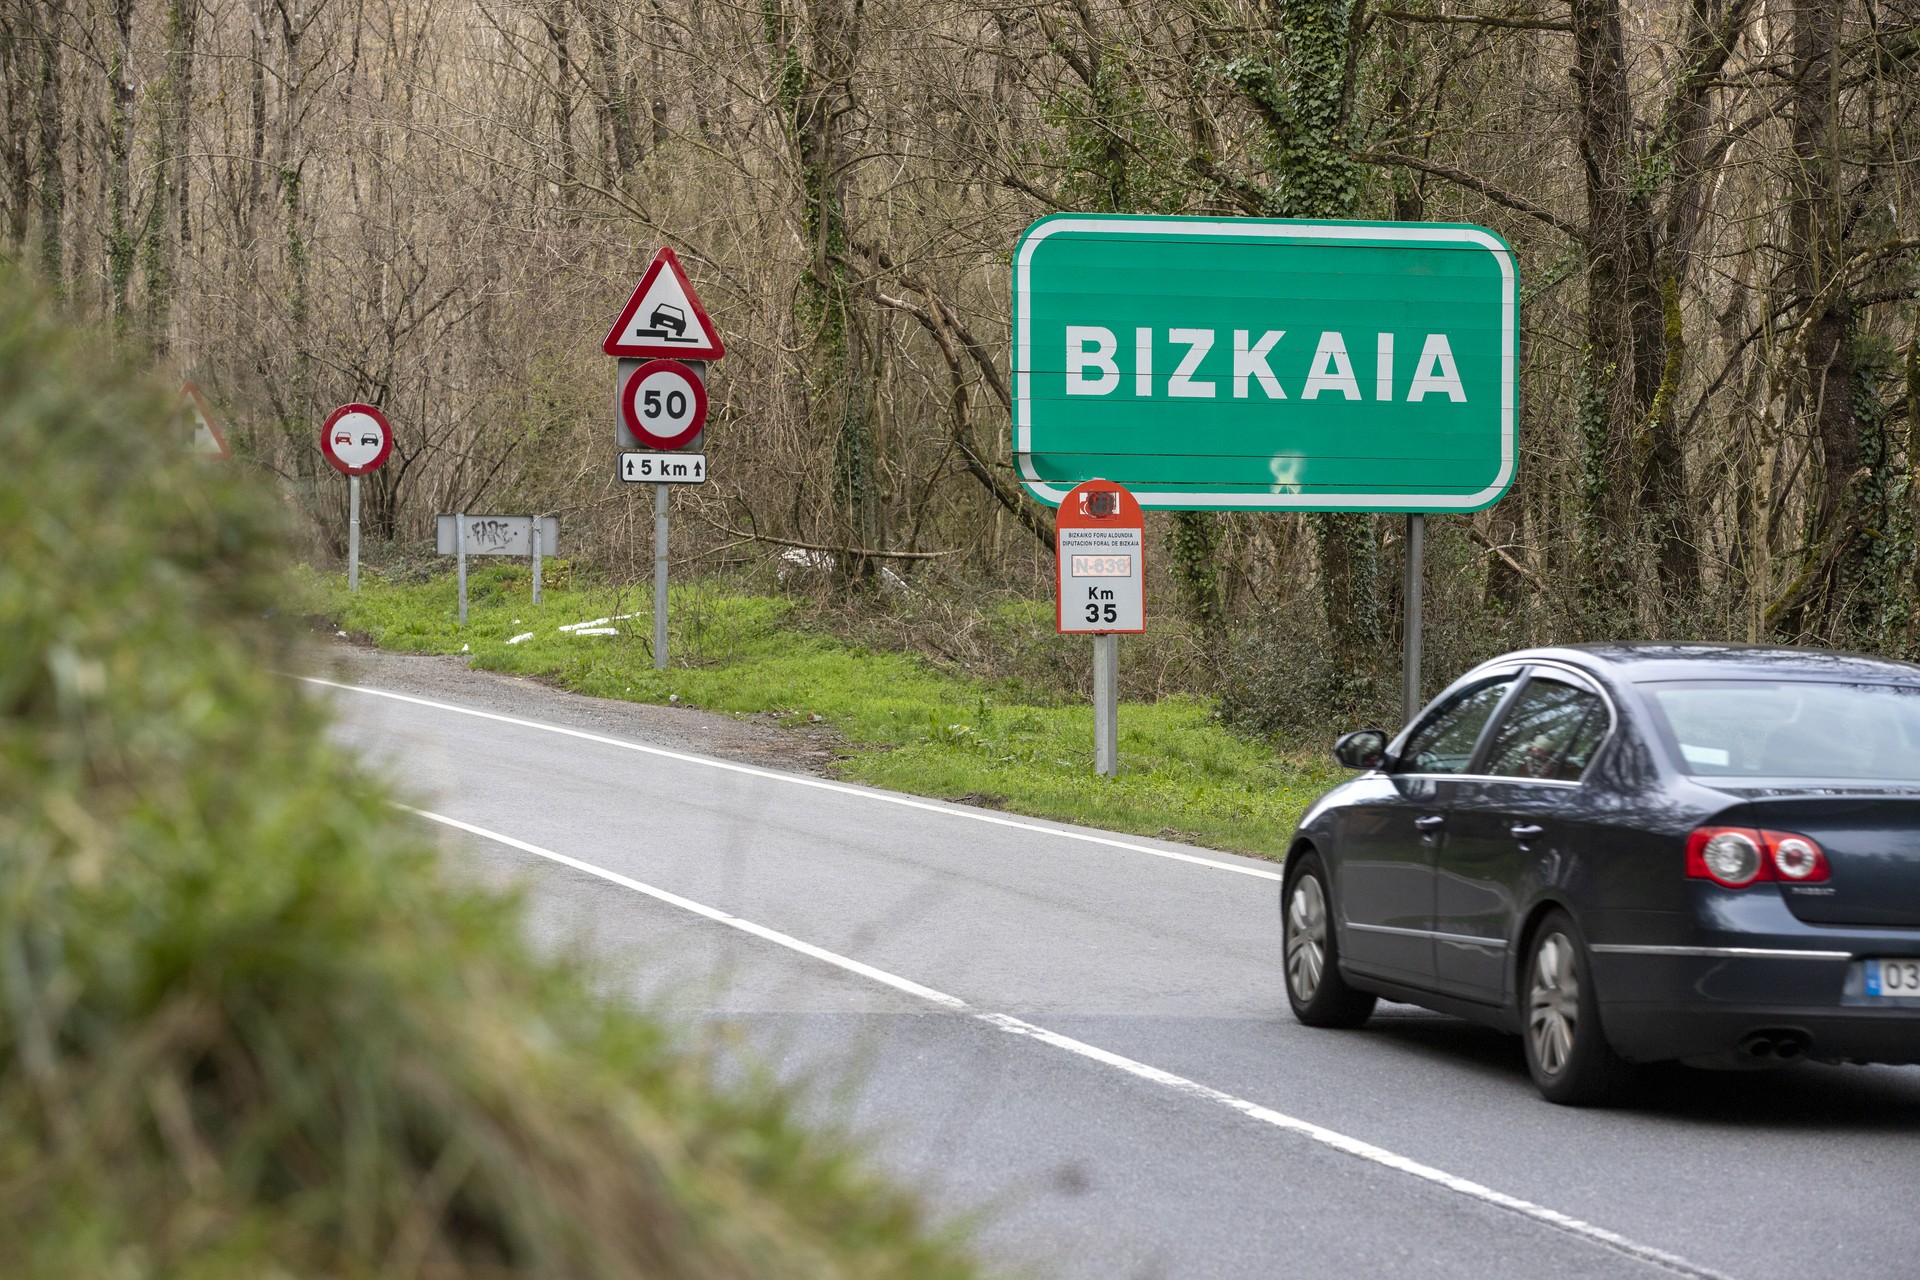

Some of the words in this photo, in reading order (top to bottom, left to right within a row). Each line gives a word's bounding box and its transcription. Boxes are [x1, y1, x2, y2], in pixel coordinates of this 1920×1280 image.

[1066, 325, 1467, 403] BIZKAIA
[643, 390, 687, 420] 50
[641, 459, 652, 476] 5
[660, 459, 688, 476] km
[1088, 586, 1114, 600] Km
[1085, 603, 1117, 623] 35
